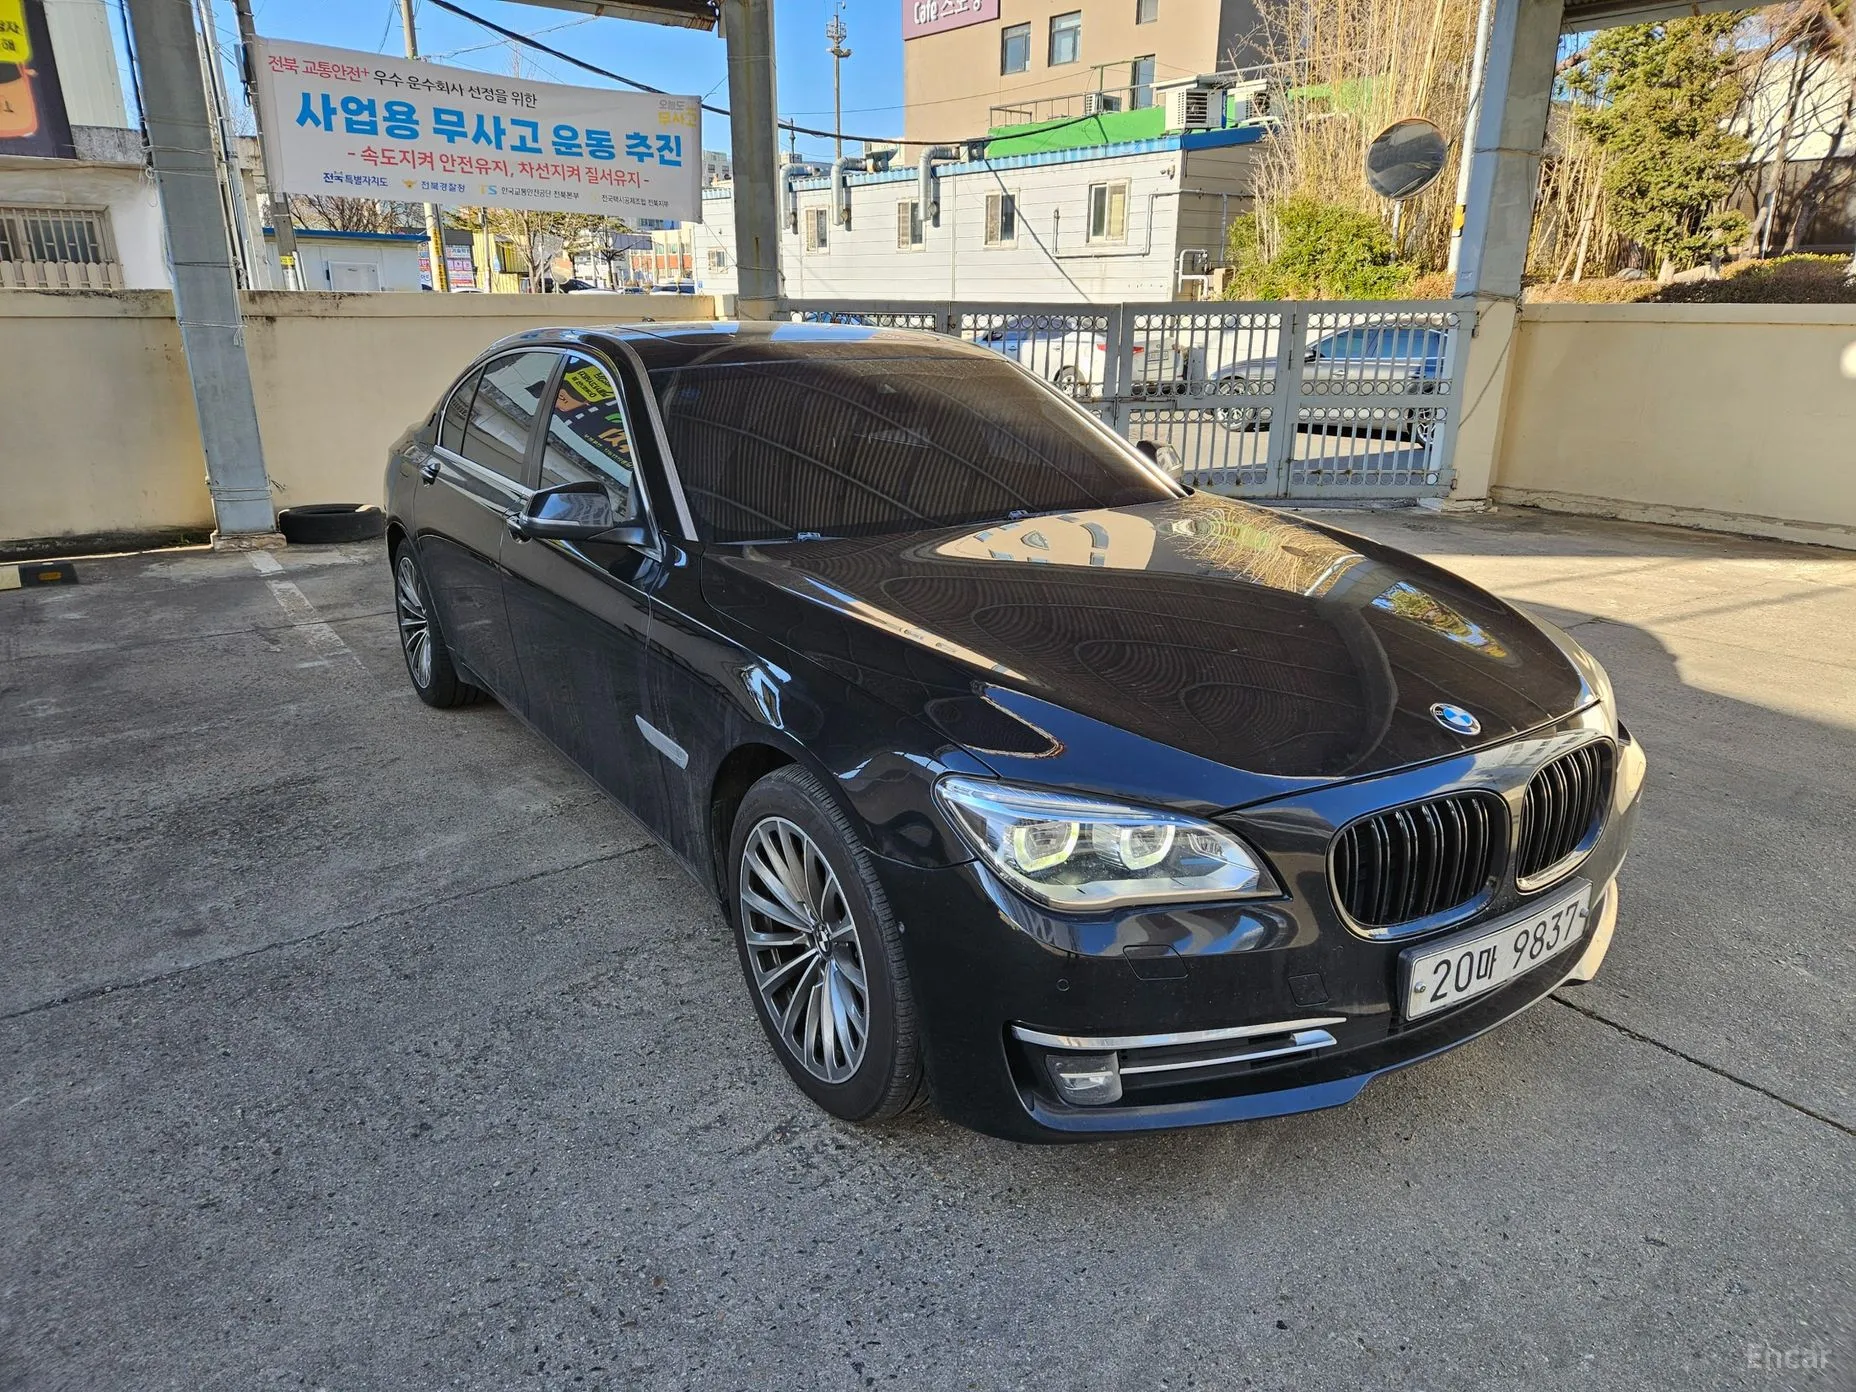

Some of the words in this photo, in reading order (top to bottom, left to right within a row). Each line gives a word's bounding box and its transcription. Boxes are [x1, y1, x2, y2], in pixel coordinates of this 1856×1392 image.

[914, 0, 938, 24] Cafe
[268, 55, 299, 74] 전북
[374, 70, 404, 87] 우수
[406, 75, 464, 97] 운수회사
[468, 86, 508, 104] 선정을
[511, 91, 538, 109] 위한
[296, 92, 421, 140] 사업용
[432, 106, 543, 154] 무사고
[552, 124, 616, 160] 운동
[625, 132, 682, 167] 추진
[421, 181, 466, 193] 전북경찰청
[439, 153, 515, 178] 안전유지,
[518, 161, 582, 183] 차선지켜
[1430, 945, 1498, 1003] 20마
[1513, 900, 1580, 970] 9837
